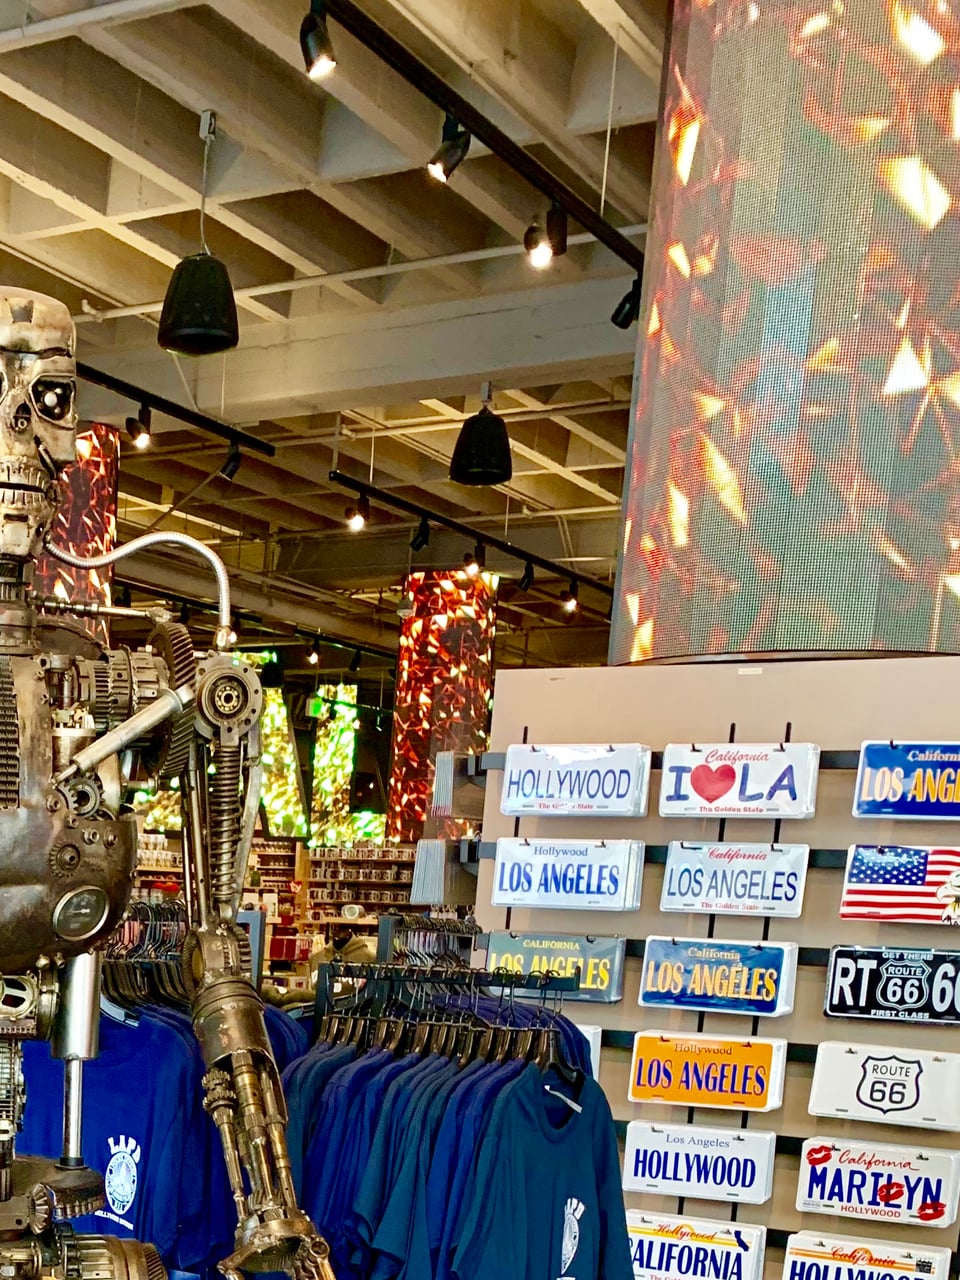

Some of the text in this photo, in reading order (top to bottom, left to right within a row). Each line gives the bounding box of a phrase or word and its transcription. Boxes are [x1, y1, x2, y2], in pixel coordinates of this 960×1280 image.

[705, 749, 769, 765] California
[507, 769, 631, 799] HOLLYWOOD
[738, 763, 797, 802] LA
[861, 767, 904, 802] LOS
[534, 847, 589, 858] Hollywood
[708, 848, 767, 863] California
[498, 862, 619, 896] LOS ANGELES
[667, 868, 798, 901] LOS ANGELES
[523, 939, 580, 950] CALIFORNIA
[688, 947, 741, 960] California
[882, 951, 933, 961] GET THERE
[646, 960, 777, 1001] LOS ANGELES
[888, 967, 923, 976] ROUTE
[832, 957, 960, 1013] RT 6
[887, 978, 919, 1003] 66
[871, 1009, 929, 1020] FIRST CLASS
[675, 1043, 733, 1056] Hollywood
[636, 1058, 766, 1096] LOS ANGELES
[872, 1064, 911, 1078] ROUTE
[869, 1080, 907, 1104] 66
[666, 1134, 730, 1148] Los Angeles
[633, 1148, 757, 1188] HOLLYWOOD
[839, 1150, 919, 1170] California
[841, 1205, 901, 1218] HOLLYWOOD
[654, 1224, 719, 1242] Hollywood
[831, 1246, 896, 1265] California
